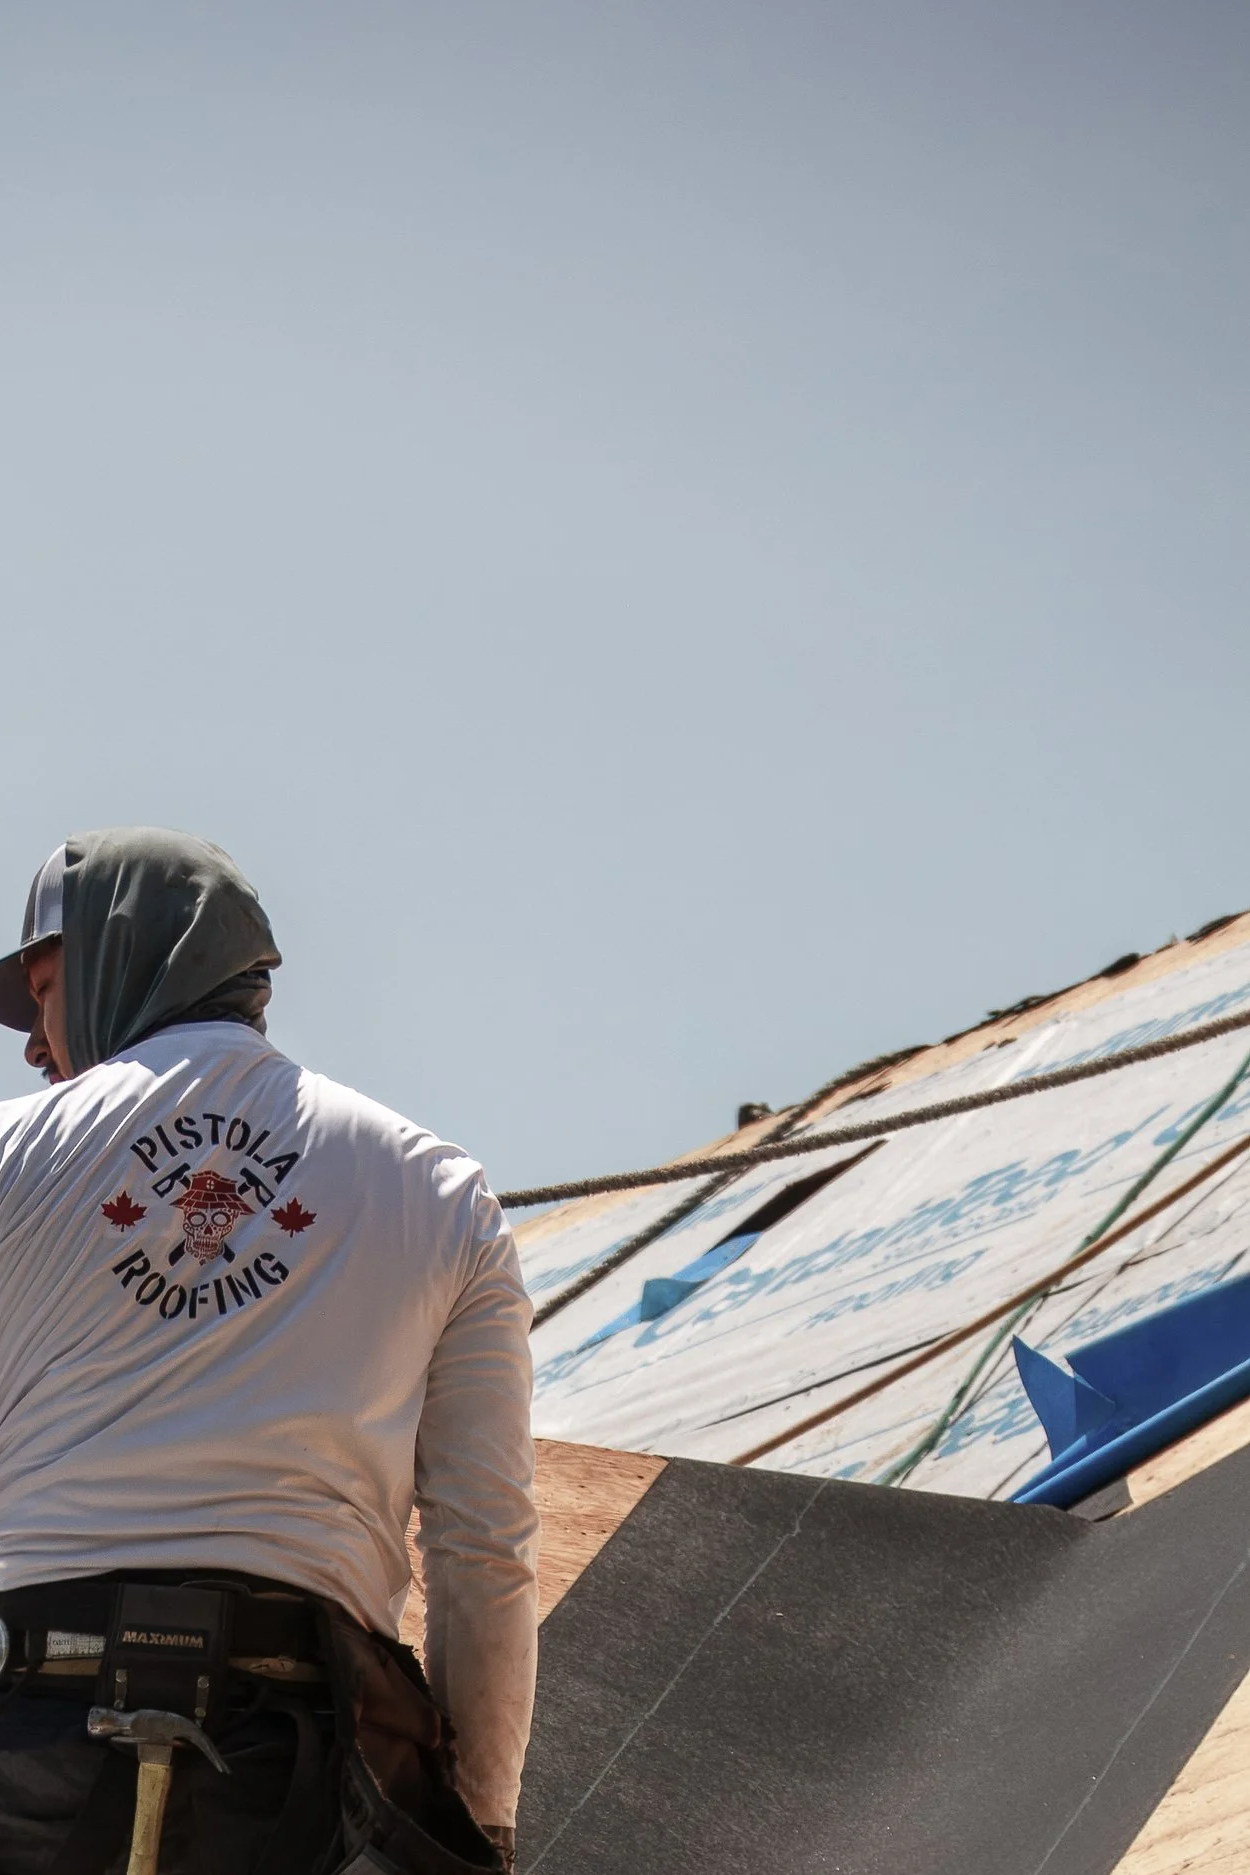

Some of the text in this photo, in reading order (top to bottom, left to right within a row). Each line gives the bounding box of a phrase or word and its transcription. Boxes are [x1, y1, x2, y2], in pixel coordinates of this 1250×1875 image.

[129, 1112, 301, 1185] PISTOLA
[111, 1248, 290, 1320] ROOFING
[121, 1630, 204, 1649] MAXIMUM
